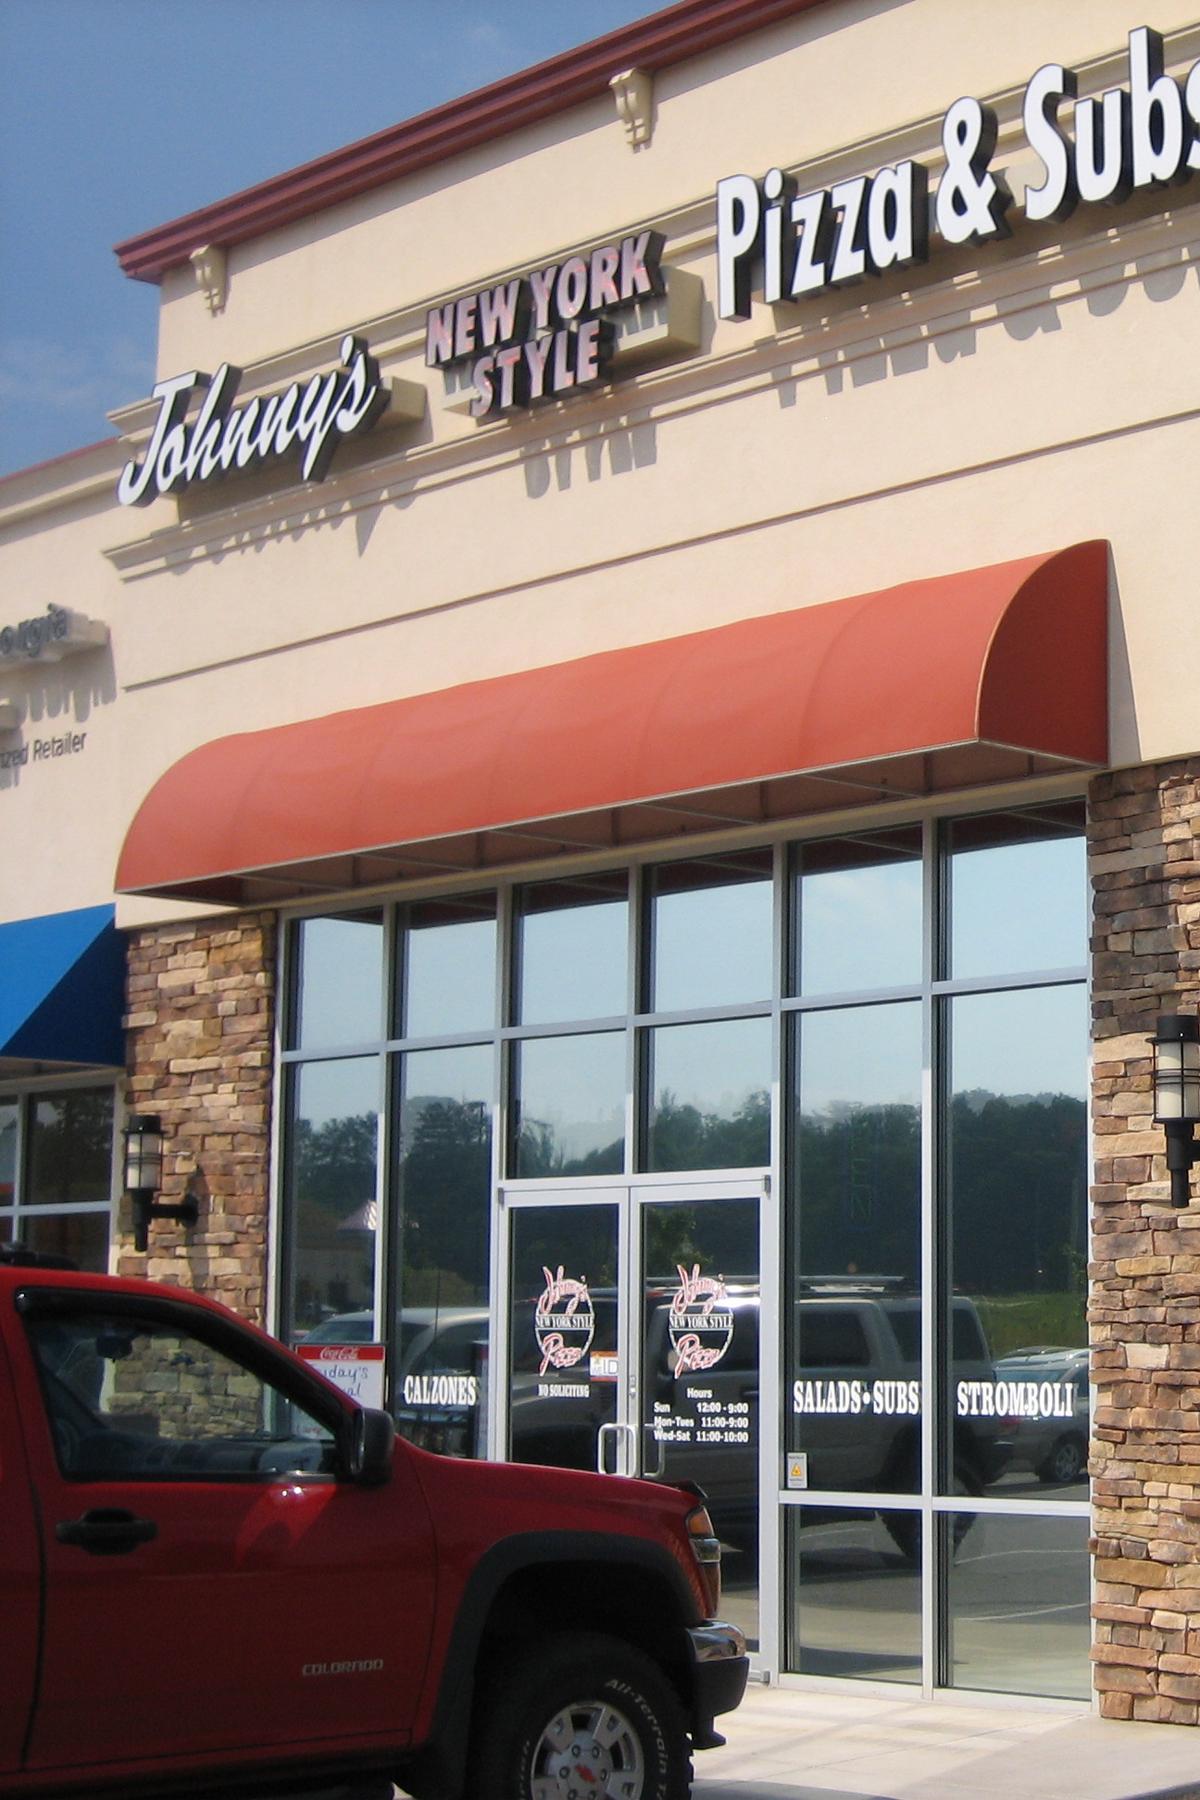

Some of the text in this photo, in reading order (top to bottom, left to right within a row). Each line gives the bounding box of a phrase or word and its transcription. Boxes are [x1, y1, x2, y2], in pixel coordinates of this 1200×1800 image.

[717, 161, 914, 320] Pizza
[936, 96, 998, 243] &
[426, 230, 654, 367] NEW YORK
[469, 319, 600, 418] STYLE
[116, 334, 378, 506] Johnny's
[33, 731, 87, 761] Retailer
[536, 1317, 594, 1328] NEW YORK STYLE
[670, 1316, 734, 1328] NEW YORK STYLE
[404, 1375, 477, 1406] CALZONES
[538, 1384, 590, 1397] NO SOLICITING
[687, 1387, 713, 1398] Hours
[957, 1381, 1074, 1417] STROMBOLI
[654, 1402, 671, 1413] Sun
[654, 1416, 694, 1427] Mon-Tues
[654, 1430, 691, 1441] Wed-Sat
[303, 1659, 384, 1676] COLORADO
